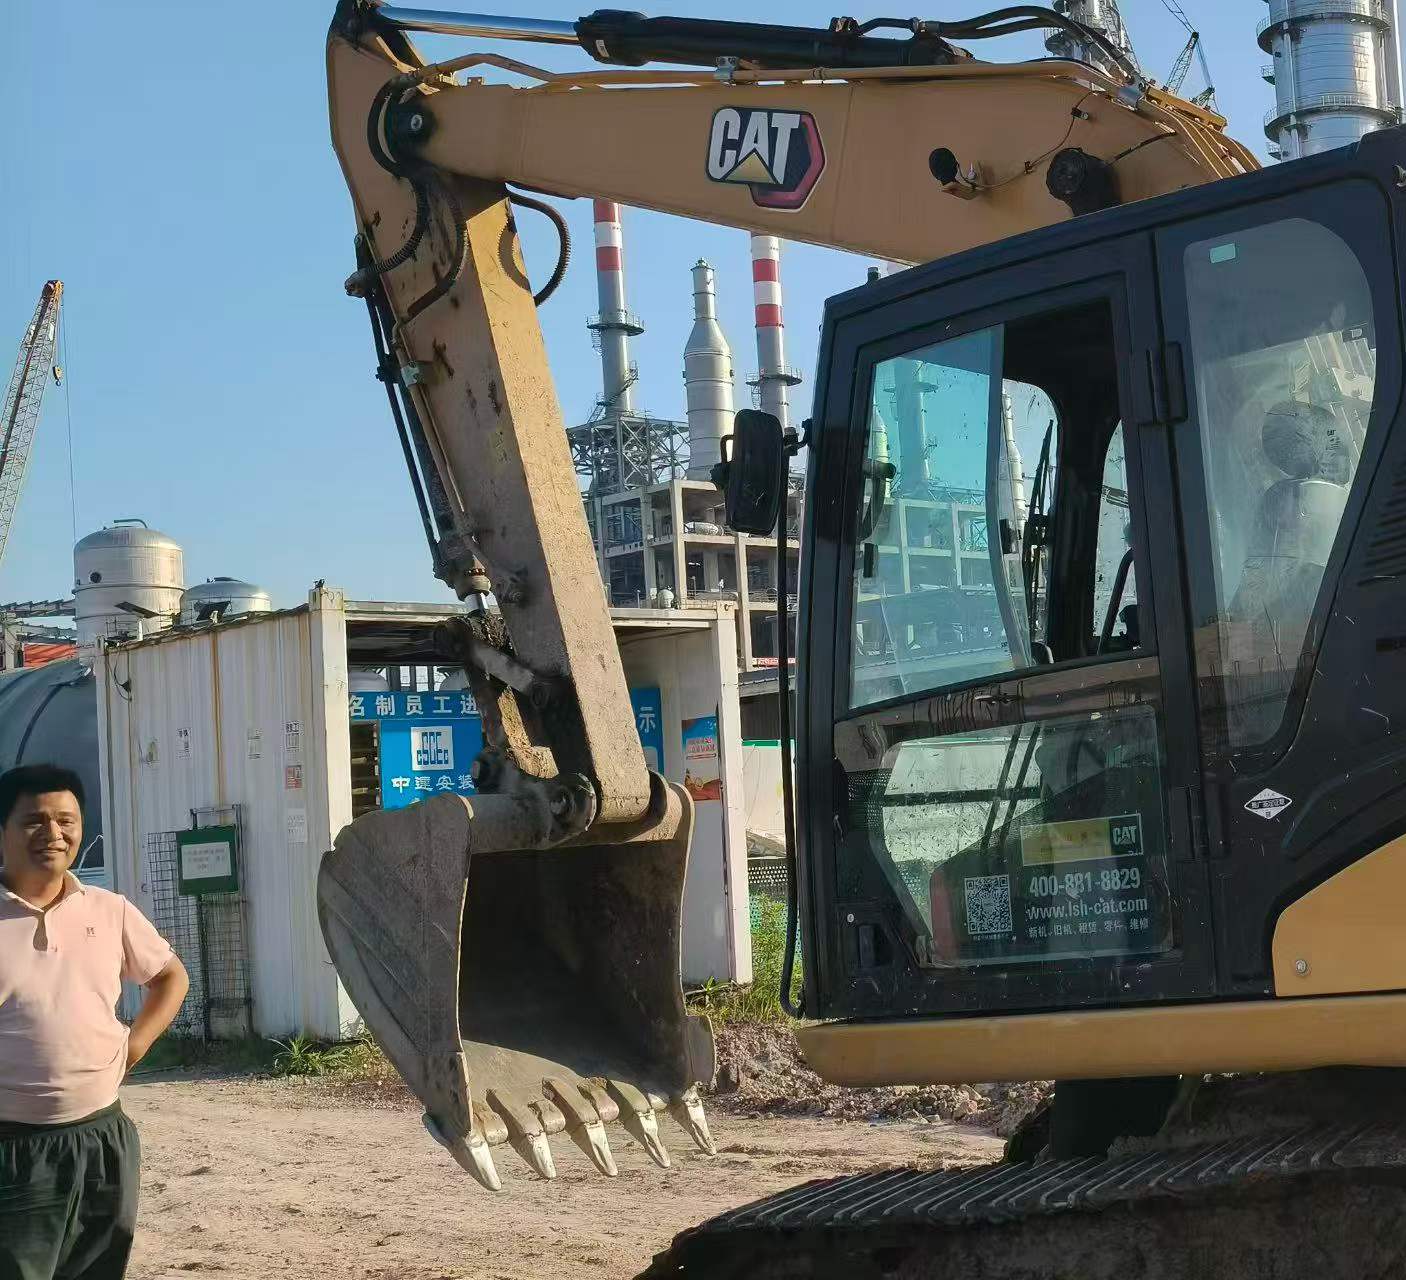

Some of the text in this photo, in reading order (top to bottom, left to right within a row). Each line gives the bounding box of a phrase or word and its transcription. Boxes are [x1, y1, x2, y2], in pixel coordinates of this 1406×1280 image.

[708, 108, 801, 184] CAT
[639, 706, 656, 733] 示
[1112, 825, 1137, 845] CAT
[1029, 867, 1140, 898] 400-881-8829
[1027, 898, 1148, 920] www.lsh-cat.com
